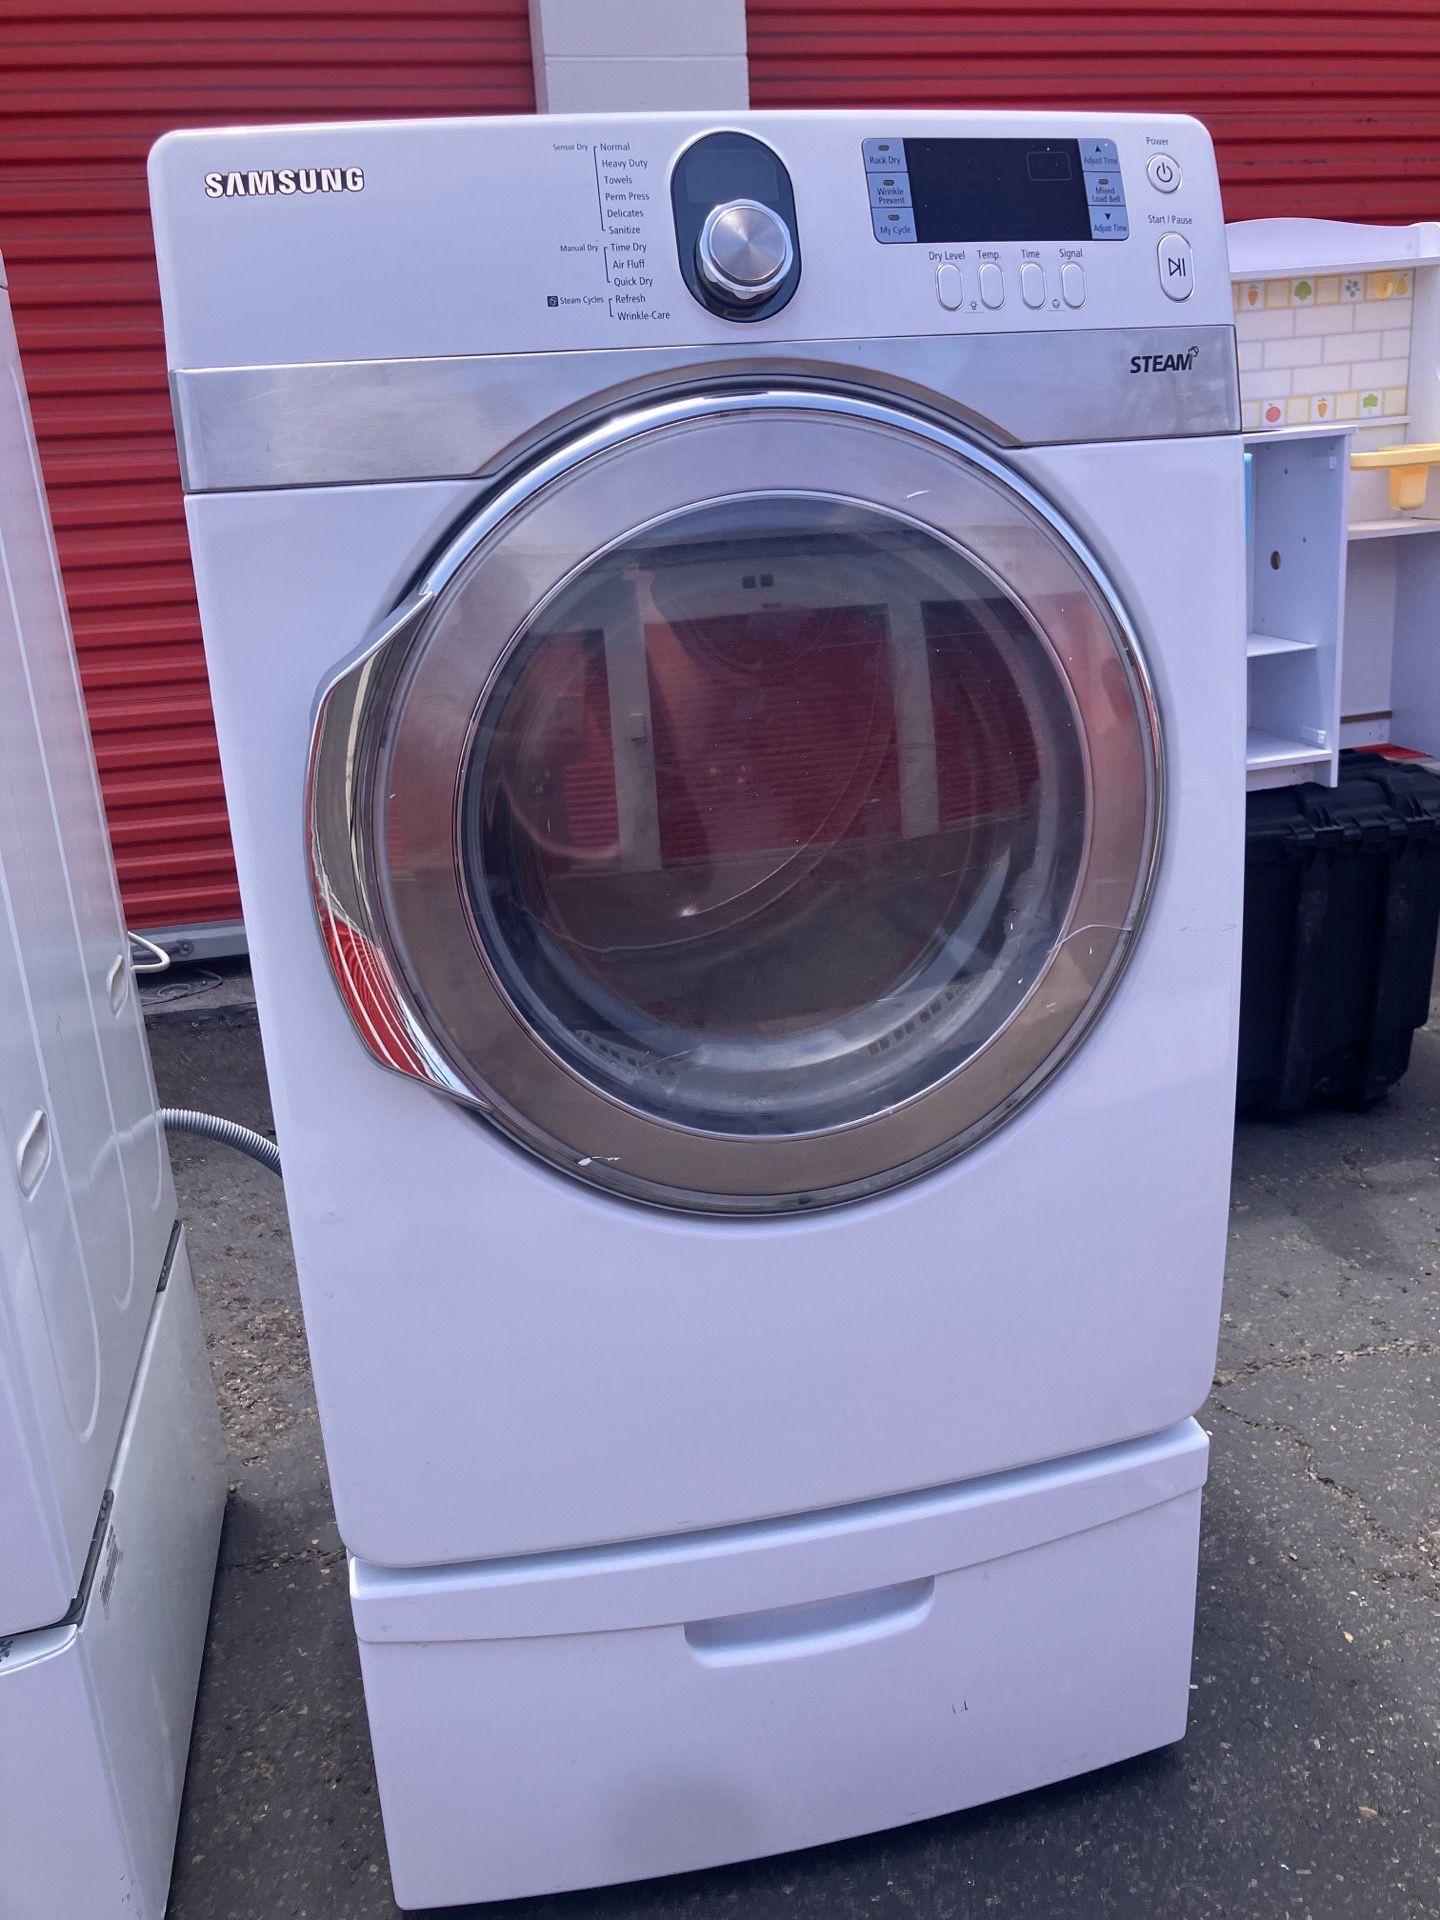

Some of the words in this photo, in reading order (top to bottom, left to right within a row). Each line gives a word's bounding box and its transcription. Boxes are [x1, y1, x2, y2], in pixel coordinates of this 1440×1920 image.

[1146, 137, 1170, 147] Power
[577, 144, 589, 152] Dry
[600, 143, 631, 151] Normal
[602, 159, 627, 169] Heavy
[629, 159, 648, 169] Duty
[869, 156, 886, 165] Rack
[888, 156, 901, 165] Dry
[1084, 157, 1103, 166] Adjust
[1104, 157, 1118, 165] Time
[205, 167, 365, 198] SAMSUNG
[604, 176, 633, 184] Towels
[877, 187, 904, 196] Wrinkle
[1095, 186, 1115, 195] Mixed
[605, 193, 627, 201] Perm
[628, 192, 650, 201] Press
[878, 197, 905, 205] Prevent
[1092, 195, 1108, 203] Load
[607, 209, 644, 218] Delicates
[1148, 214, 1165, 224] Start
[1172, 215, 1193, 225] Pause
[608, 226, 641, 235] Sanitize
[880, 226, 892, 235] My
[893, 226, 911, 235] Cycle
[1094, 224, 1112, 233] Adjust
[1113, 224, 1128, 232] Time
[560, 245, 585, 253] Manual
[587, 245, 599, 254] Dry
[611, 243, 630, 252] Time
[632, 243, 647, 253] Dry
[928, 251, 943, 262] Dry
[945, 250, 966, 260] Level
[977, 250, 1002, 260] Temp.
[1021, 250, 1040, 259] Time
[1059, 248, 1083, 259] Signal
[612, 261, 625, 270] Air
[627, 259, 645, 269] Fluff
[614, 277, 637, 287] Quick
[639, 277, 653, 287] Dry
[560, 297, 582, 305] Steam
[583, 296, 604, 305] Cycles
[615, 294, 646, 304] Refresh
[617, 310, 671, 321] Wrinkle-Care
[1130, 353, 1194, 373] STEAM
